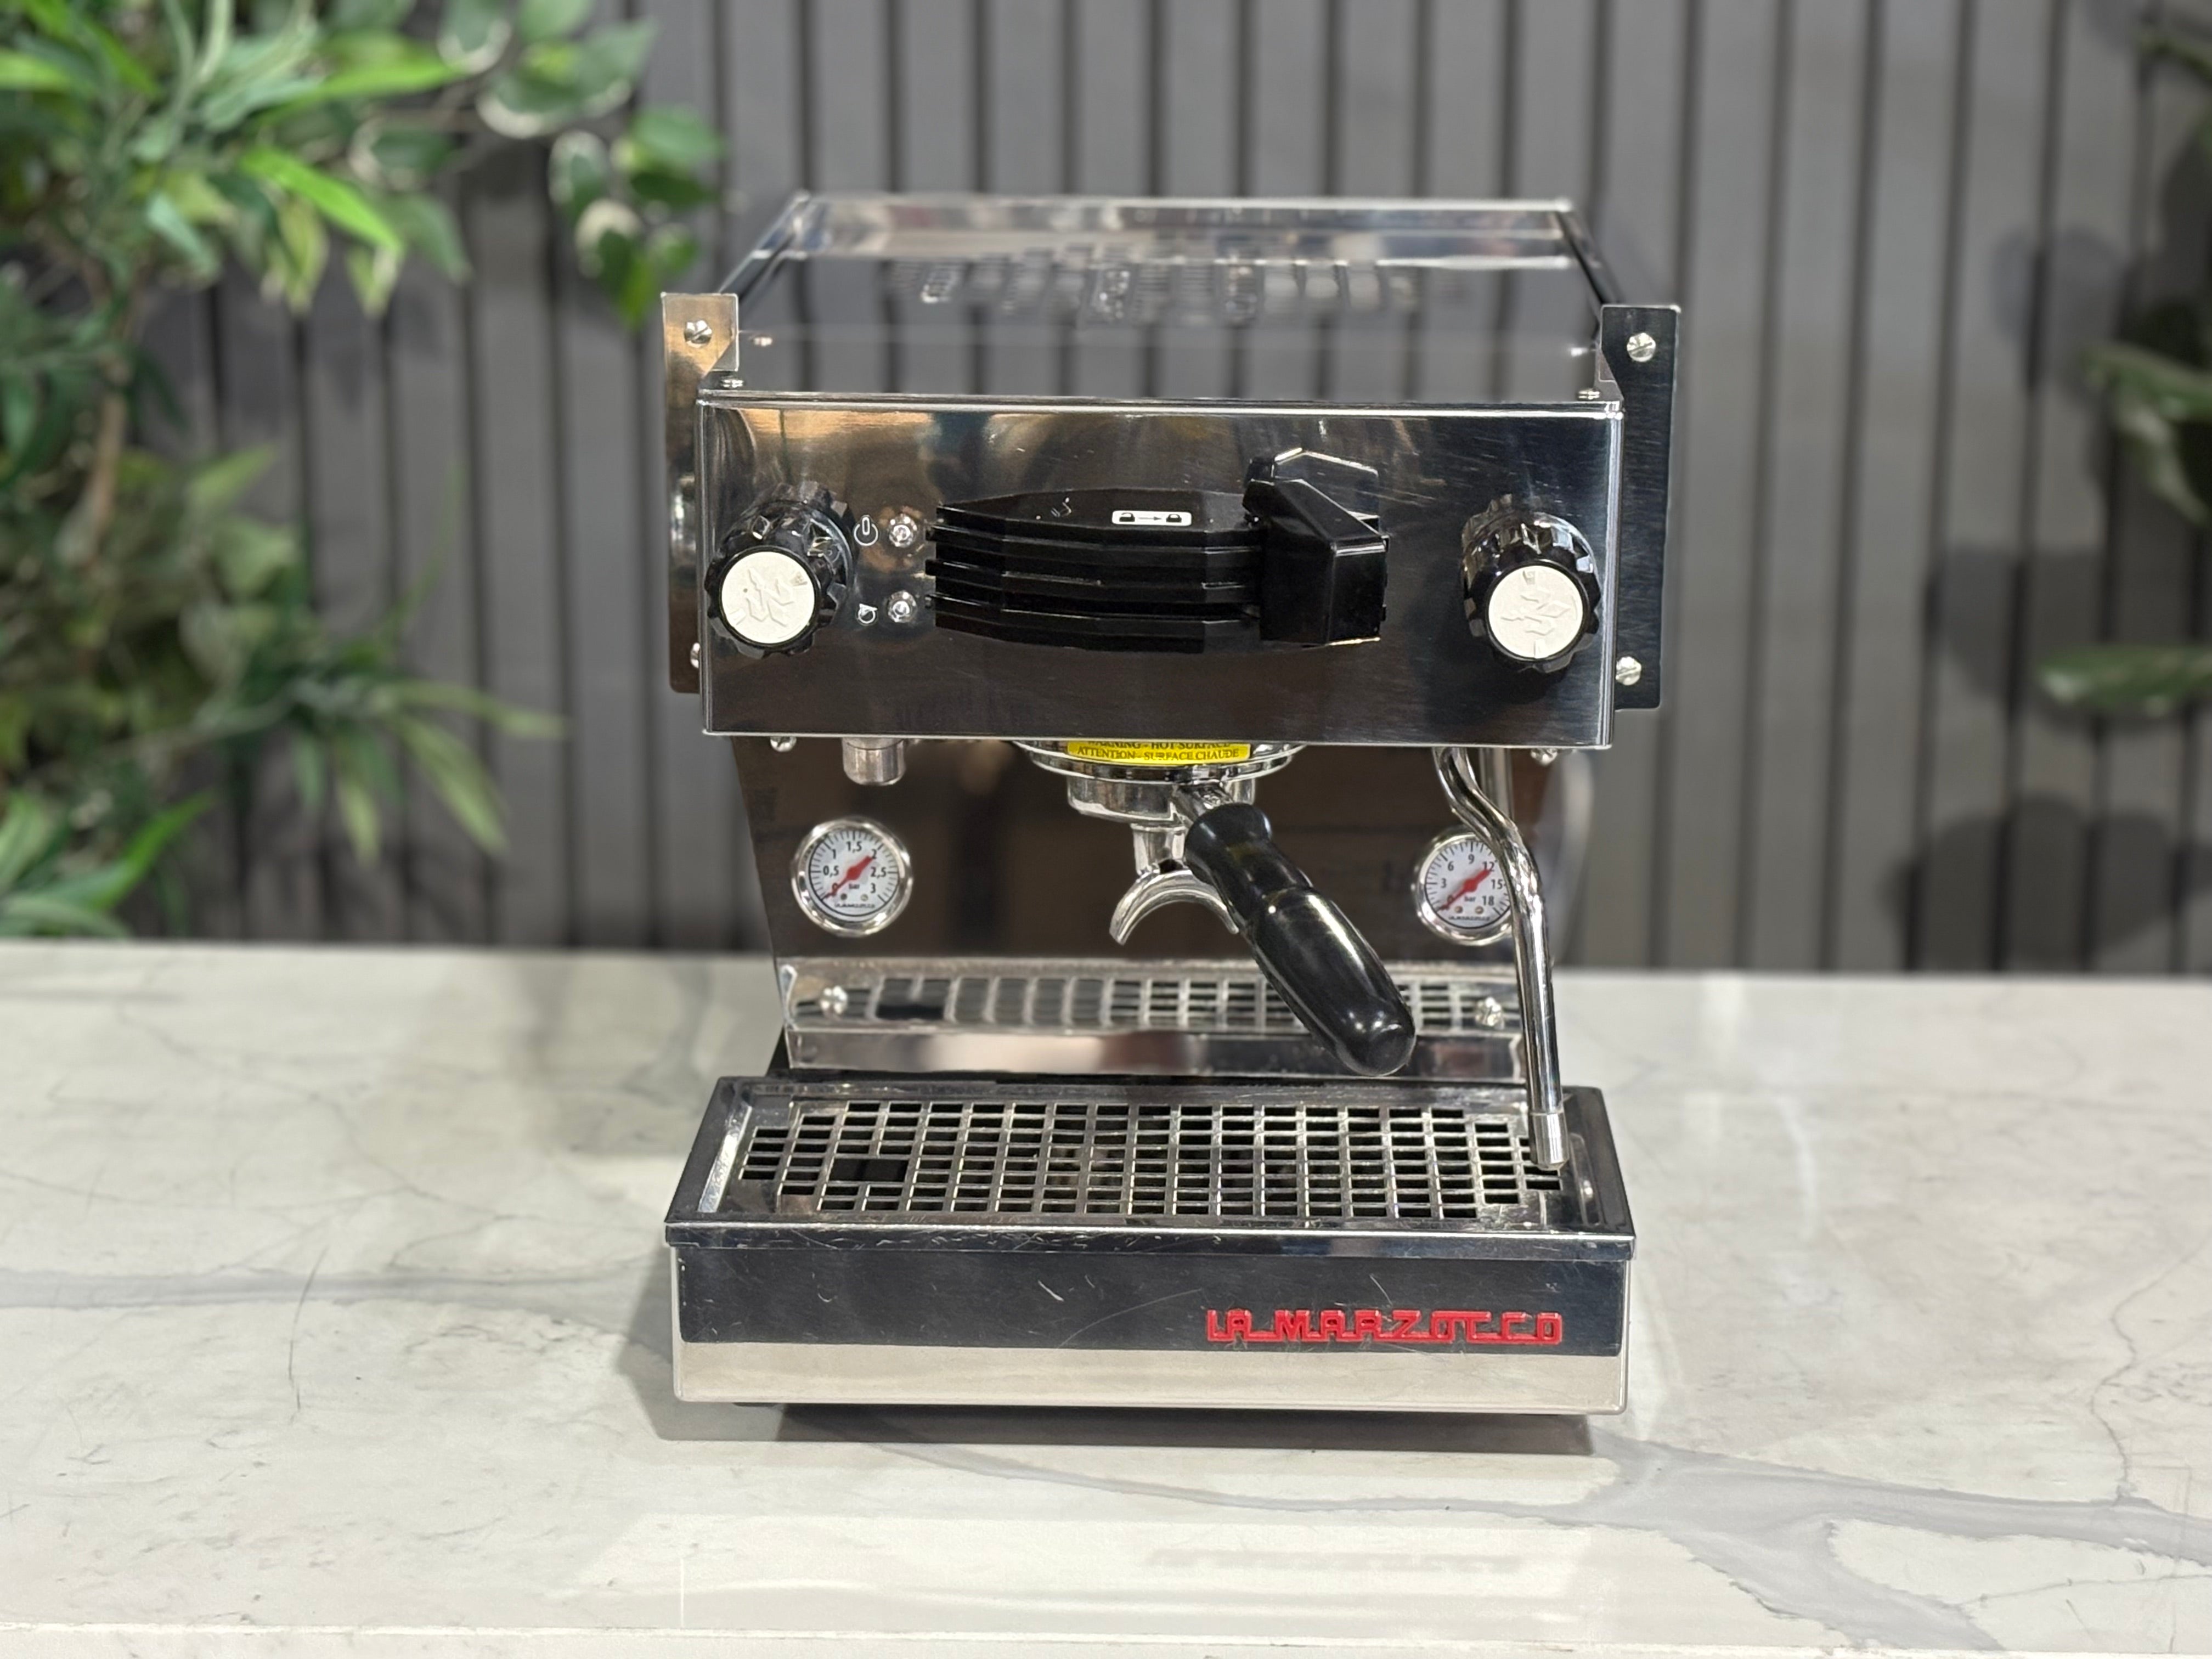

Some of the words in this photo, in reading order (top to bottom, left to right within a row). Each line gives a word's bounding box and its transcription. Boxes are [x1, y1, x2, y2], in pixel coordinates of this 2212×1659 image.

[1077, 746, 1136, 759] ATTENTION
[1144, 751, 1193, 760] SURFACE
[1195, 748, 1239, 760] CHAUDE
[846, 841, 862, 853] 1,5
[832, 849, 837, 859] 1
[871, 849, 877, 859] 2
[1468, 854, 1475, 864] 9
[823, 865, 839, 878] 0,5
[1447, 861, 1454, 871] 6
[1482, 861, 1495, 872] 12
[871, 866, 887, 878] 2,5
[870, 883, 876, 893] 3
[1441, 877, 1447, 888] 3
[1491, 879, 1503, 889] 15
[1482, 895, 1495, 906] 18
[1207, 1309, 1252, 1342] LA
[1275, 1309, 1562, 1344] MARZOCCO
